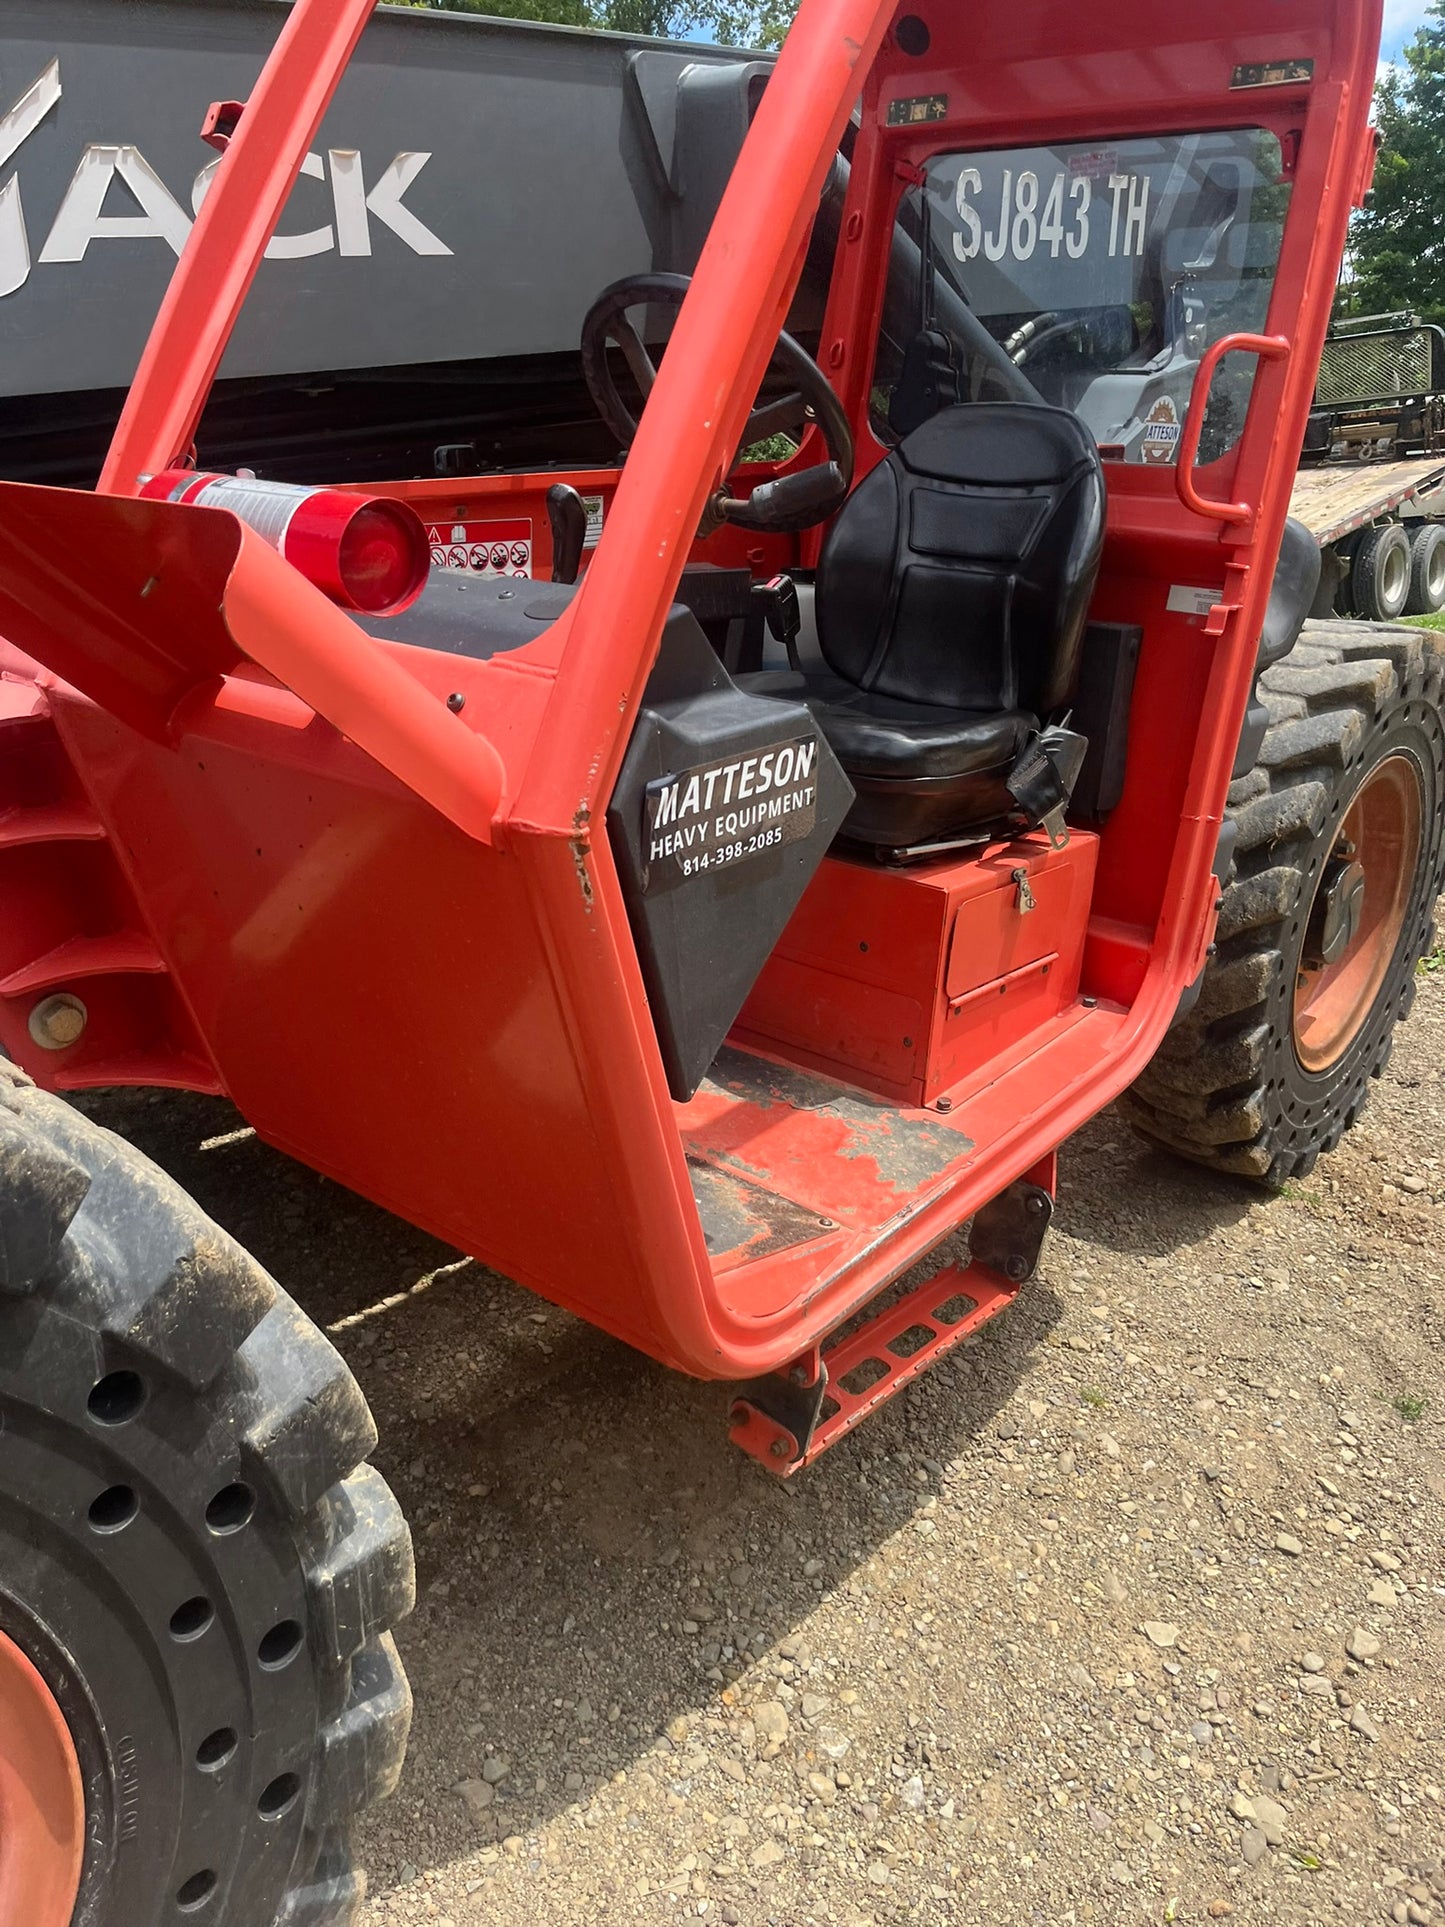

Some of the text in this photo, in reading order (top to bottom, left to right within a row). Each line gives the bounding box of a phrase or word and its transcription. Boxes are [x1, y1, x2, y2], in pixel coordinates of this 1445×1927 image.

[953, 168, 1150, 262] SJ843 TH
[1147, 425, 1179, 440] ATTESON
[654, 742, 814, 829] MATTESON
[651, 788, 814, 861] HEAVY EQUIPMENT
[684, 827, 783, 876] 814-398-2085
